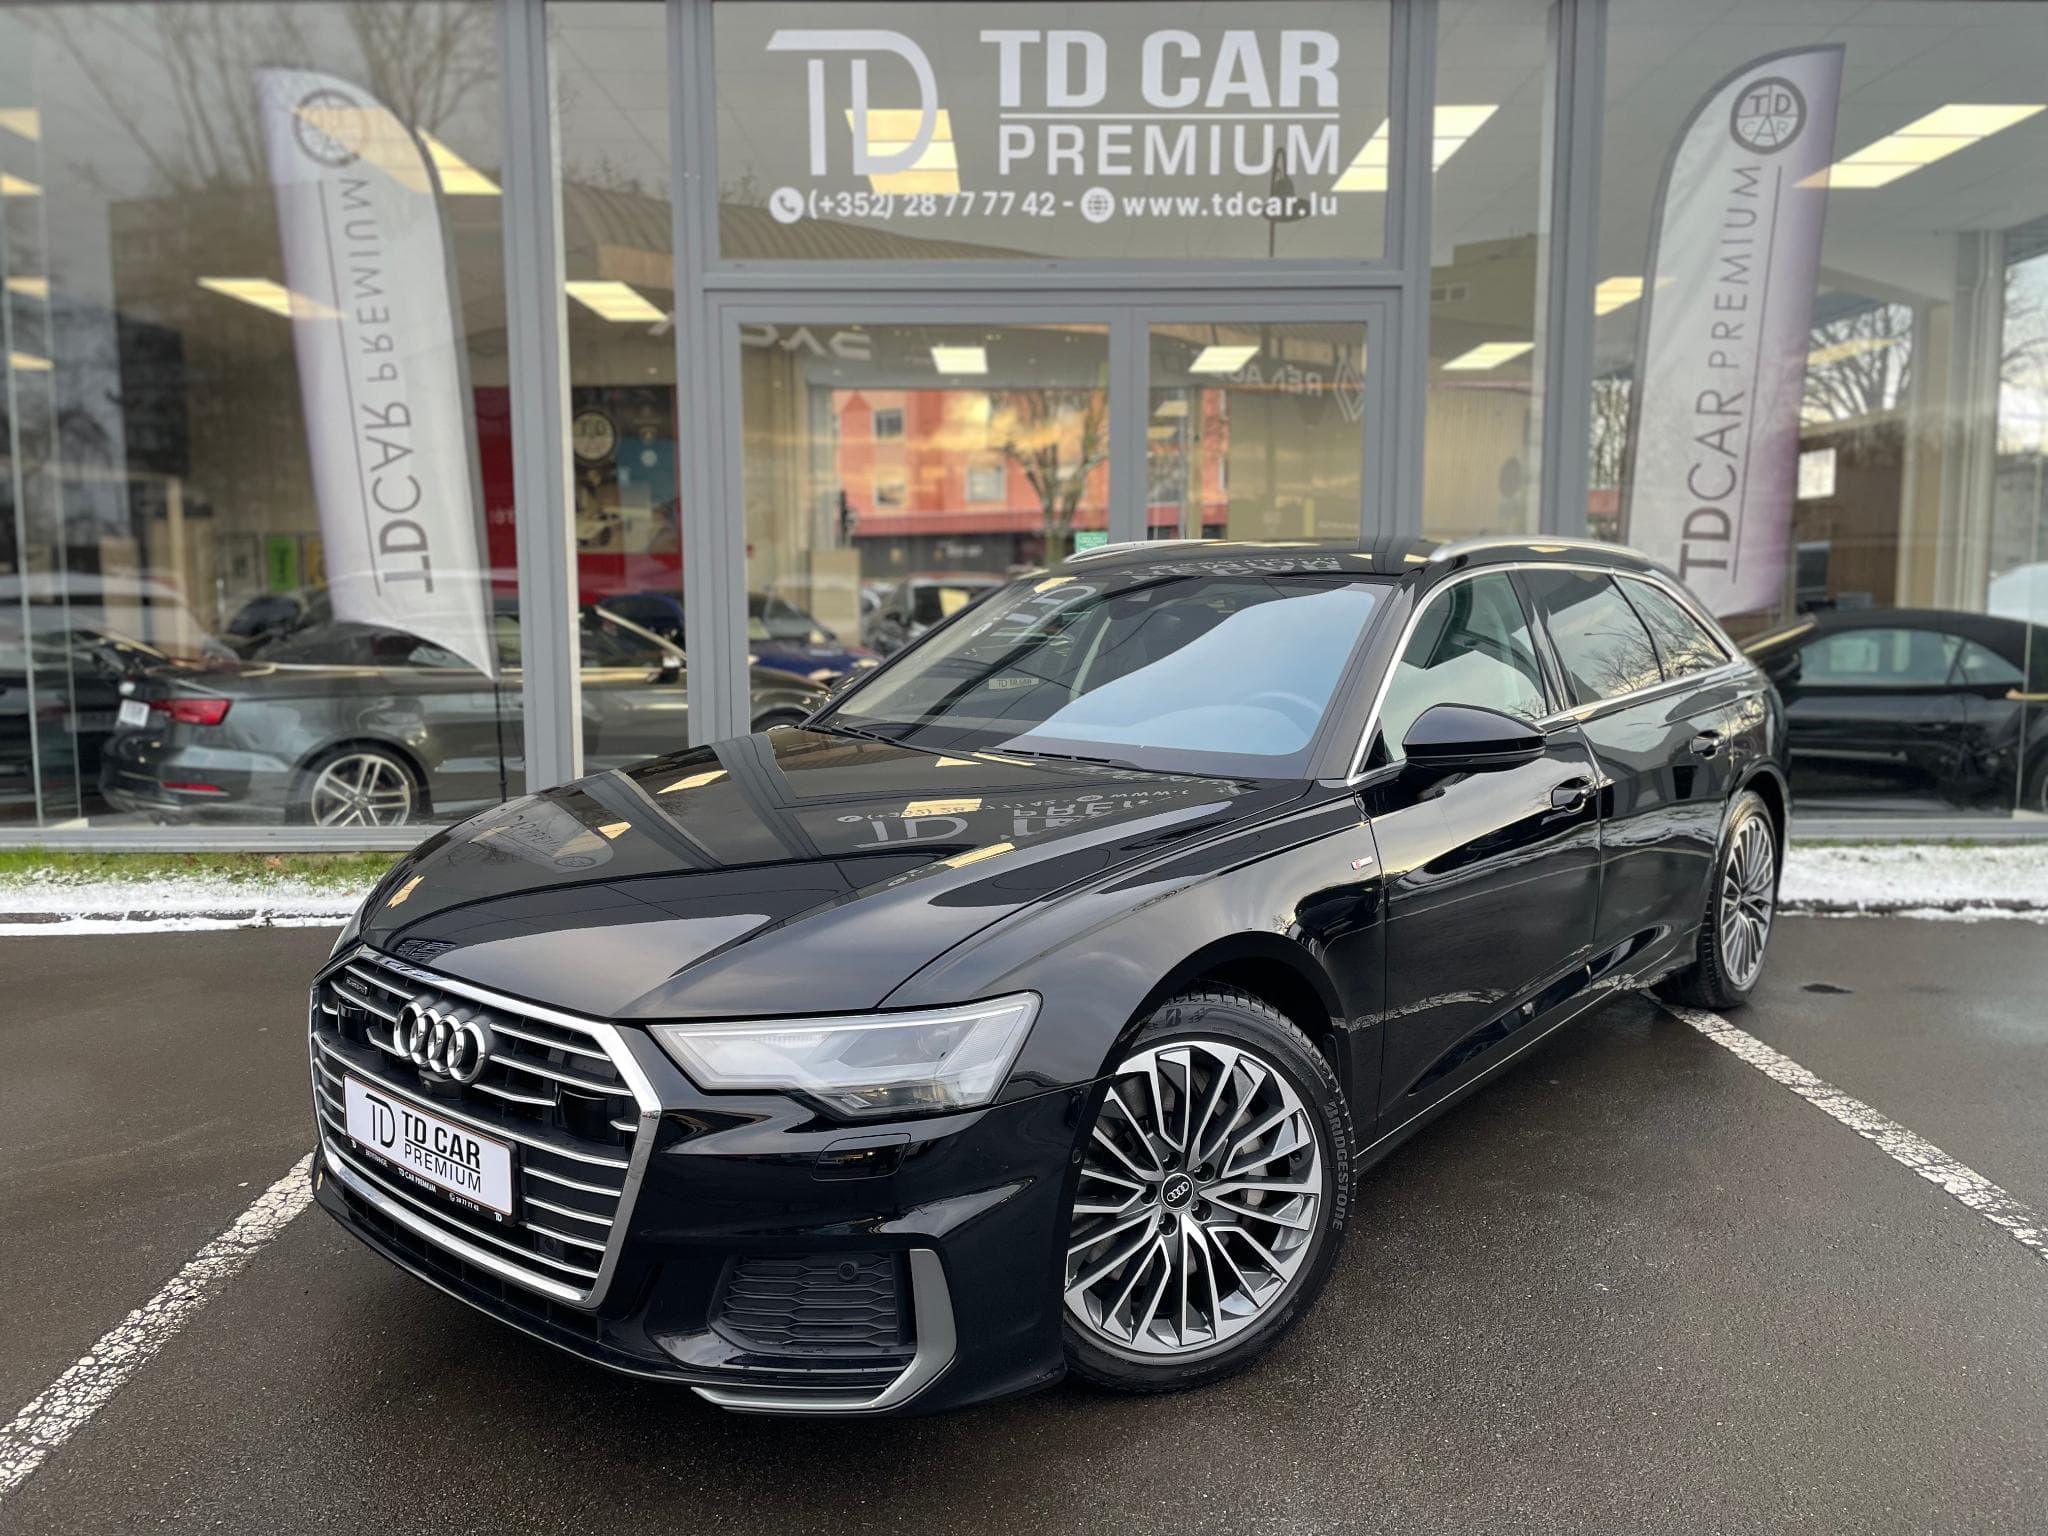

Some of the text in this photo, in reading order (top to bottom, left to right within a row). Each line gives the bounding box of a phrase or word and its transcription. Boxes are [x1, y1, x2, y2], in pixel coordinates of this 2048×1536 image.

[980, 29, 1341, 108] TD CAR
[1749, 92, 1792, 115] TD
[999, 124, 1340, 177] PREMIUM
[808, 188, 895, 219] (+352)
[903, 191, 937, 218] 28
[943, 191, 976, 217] 77
[982, 191, 1016, 217] 77
[1021, 191, 1056, 218] 42
[1122, 191, 1339, 218] www.tdcar.lu
[1708, 166, 1762, 370] PREMIUM
[401, 1110, 427, 1145] TD
[434, 1126, 481, 1170] CAR
[404, 1141, 482, 1193] PREMIUM
[1323, 1100, 1349, 1231] BRIDGESTONE
